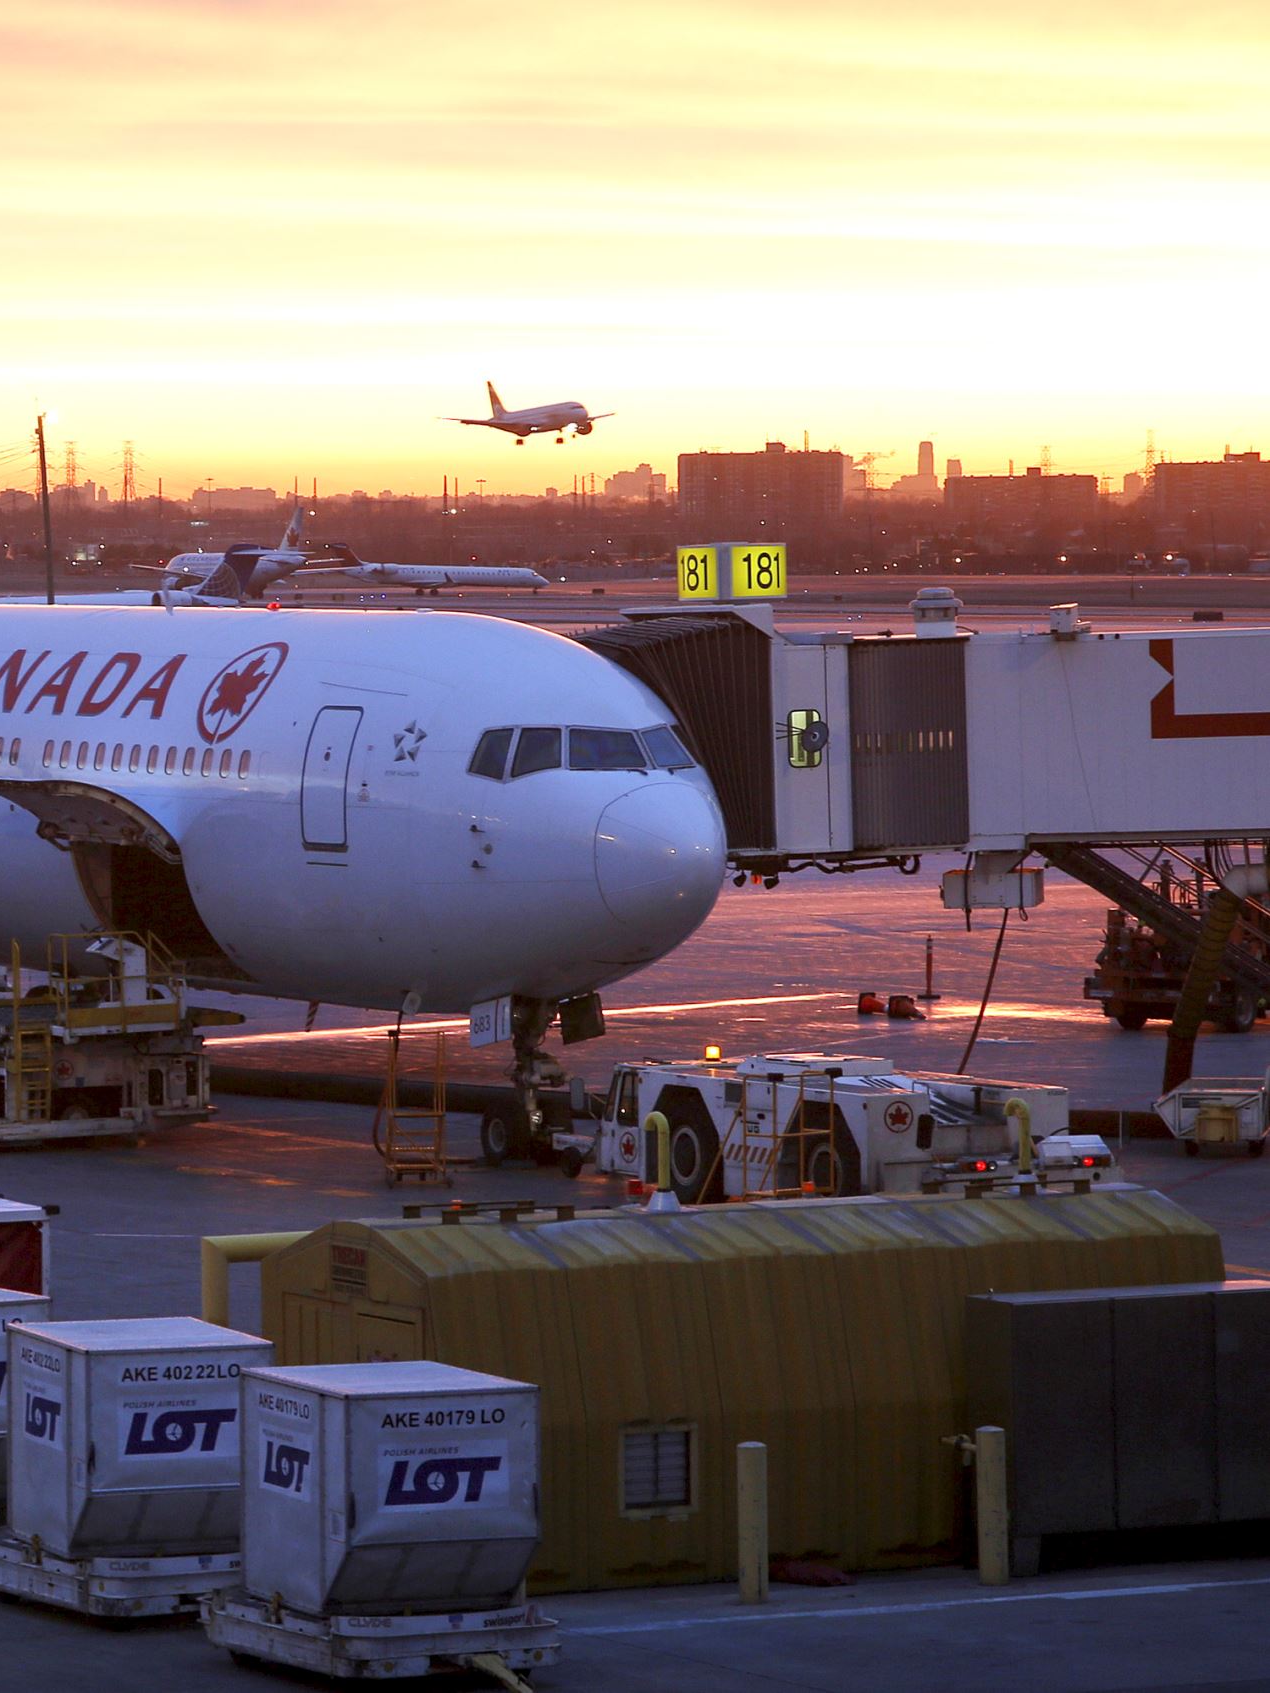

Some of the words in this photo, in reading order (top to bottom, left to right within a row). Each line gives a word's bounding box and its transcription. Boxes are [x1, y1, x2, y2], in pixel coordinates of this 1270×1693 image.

[681, 554, 708, 591] 181
[742, 552, 780, 589] 181
[121, 1366, 158, 1382] AKE
[25, 1392, 61, 1441] LOT
[123, 1401, 155, 1409] POLISH
[156, 1400, 197, 1408] AIRLINES
[259, 1392, 274, 1411] AKE
[275, 1397, 298, 1416] 40179
[298, 1402, 310, 1419] LO
[381, 1412, 420, 1428] AKE
[424, 1410, 475, 1426] 40179
[481, 1408, 506, 1424] LO
[124, 1408, 237, 1455] LOT
[263, 1440, 310, 1493] LOT
[384, 1448, 416, 1456] POLISH
[418, 1446, 459, 1455] AIRLINES
[384, 1456, 502, 1506] LOT
